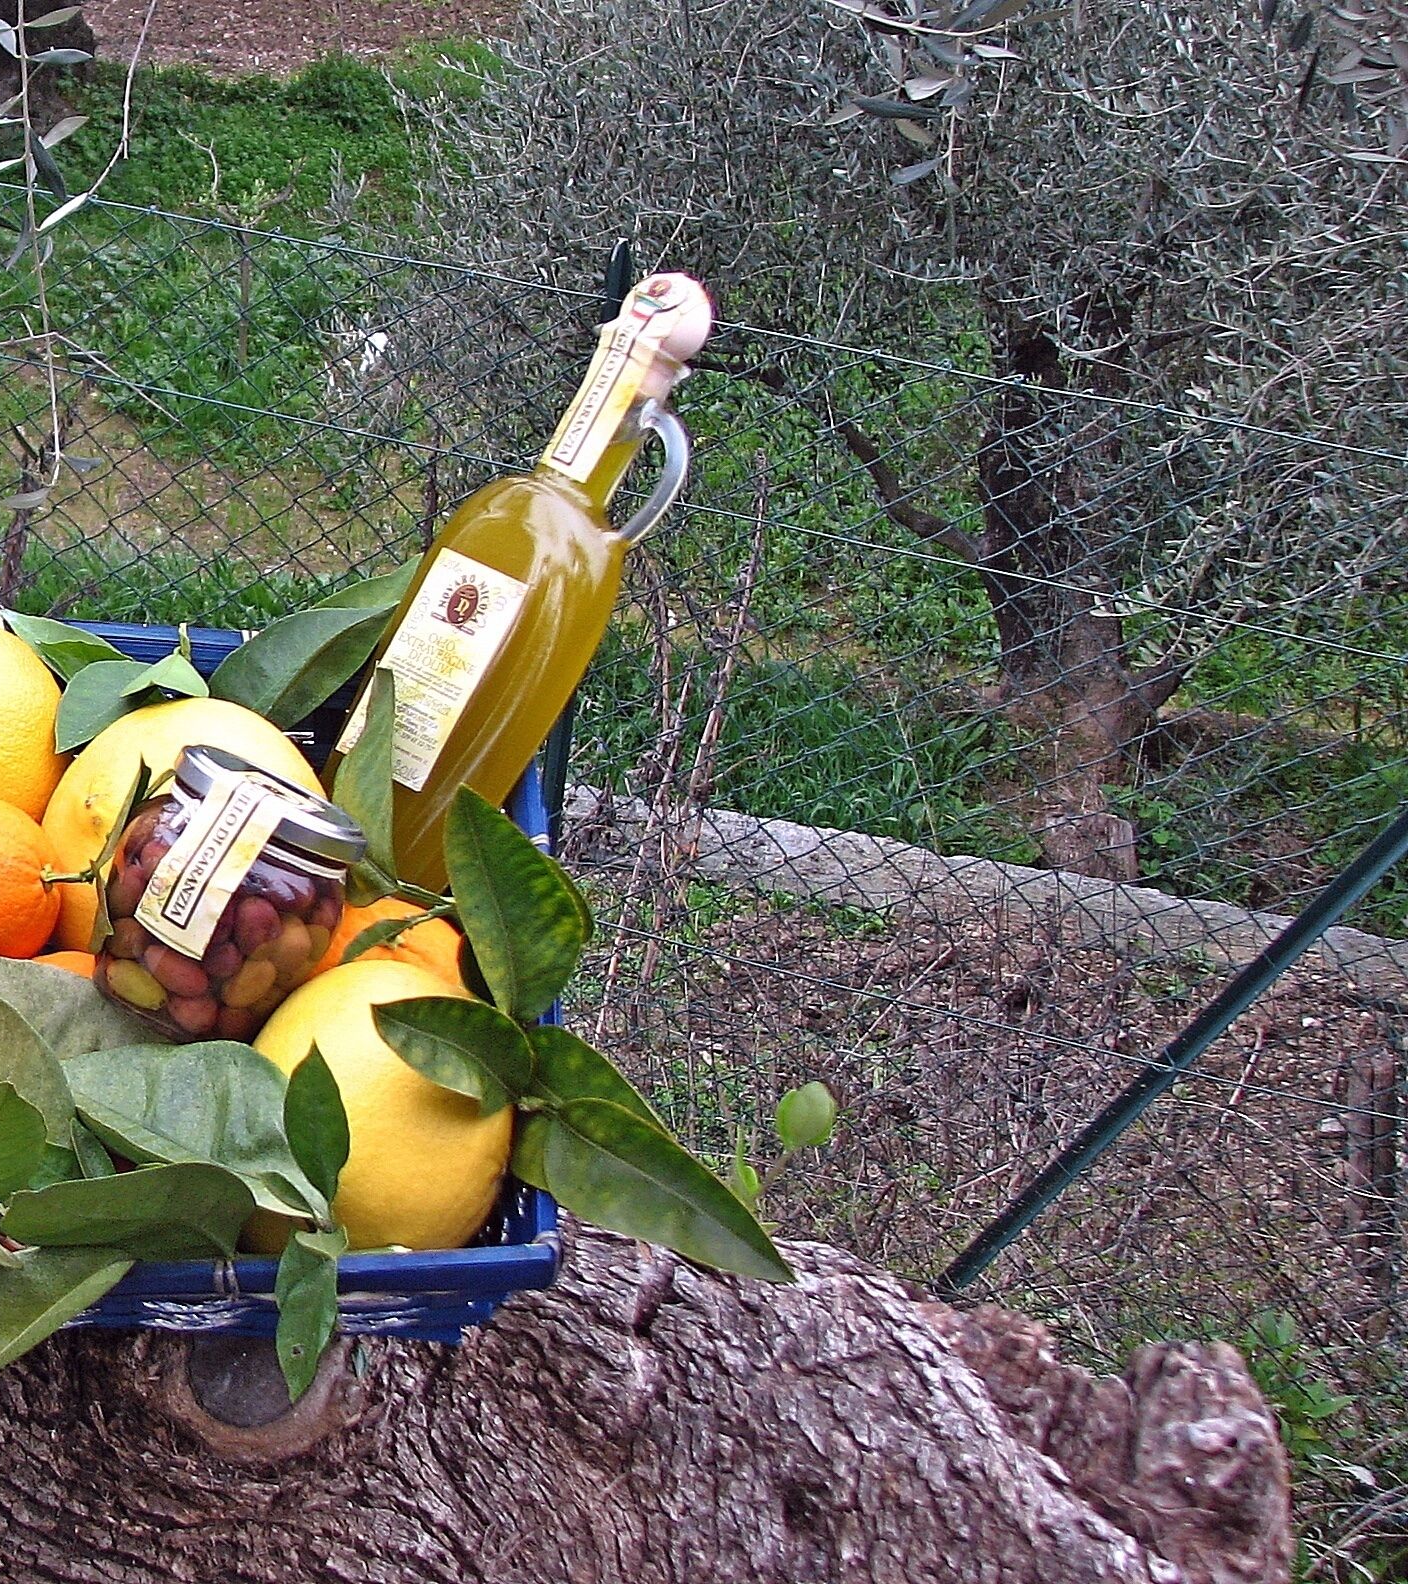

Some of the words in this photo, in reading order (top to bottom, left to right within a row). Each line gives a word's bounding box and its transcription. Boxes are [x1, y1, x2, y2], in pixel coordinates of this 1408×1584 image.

[595, 373, 611, 390] DI
[559, 390, 603, 455] GARANZIA
[438, 574, 476, 608] NOVARO
[470, 580, 490, 624] NICOLA
[212, 828, 230, 846] DI
[170, 846, 216, 917] GARANZIA
